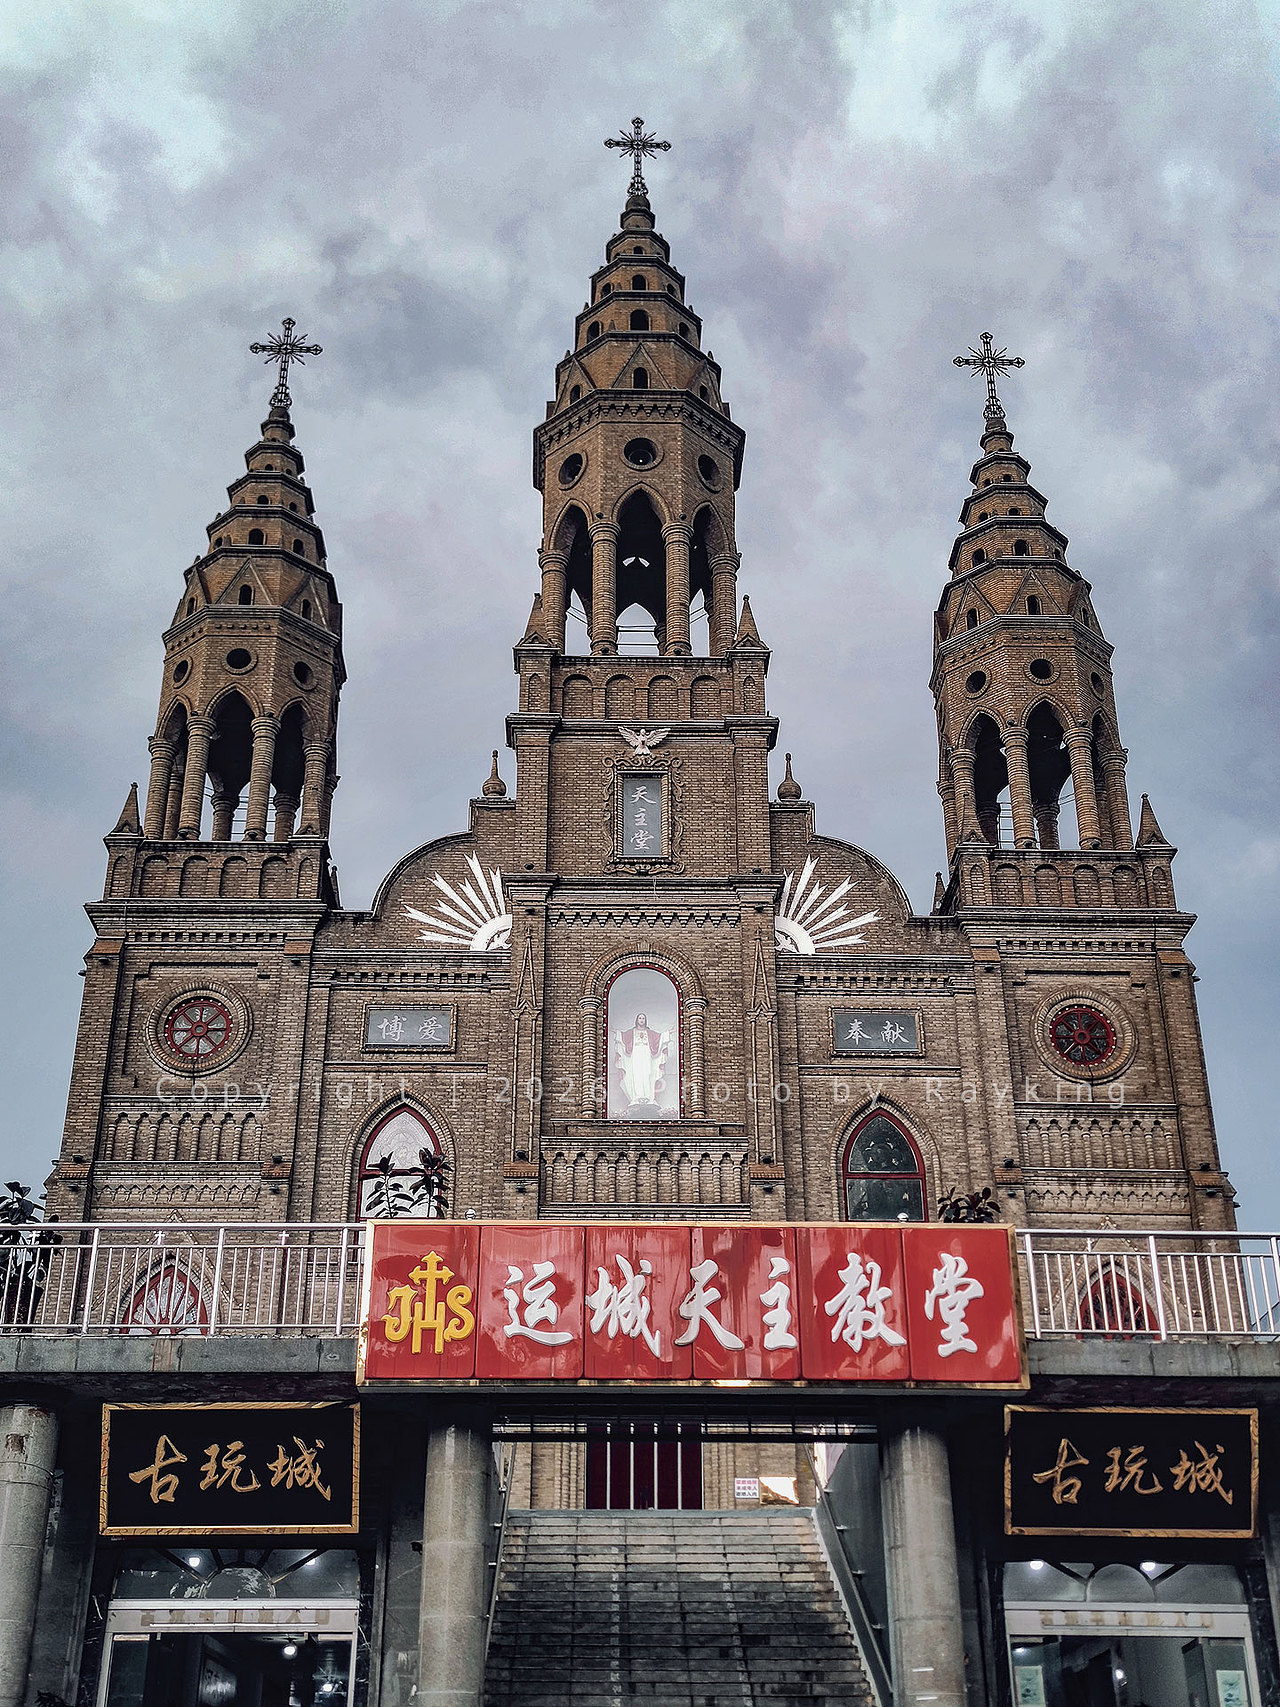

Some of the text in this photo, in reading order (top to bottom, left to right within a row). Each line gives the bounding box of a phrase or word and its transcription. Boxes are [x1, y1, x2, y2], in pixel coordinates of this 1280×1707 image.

[630, 785, 657, 851] 天主堂
[377, 1016, 443, 1042] 博爱
[844, 1019, 910, 1045] 奉献
[503, 1252, 985, 1359] 运城天主教堂
[128, 1435, 333, 1504] 古玩城
[1032, 1438, 1234, 1505] 古玩城
